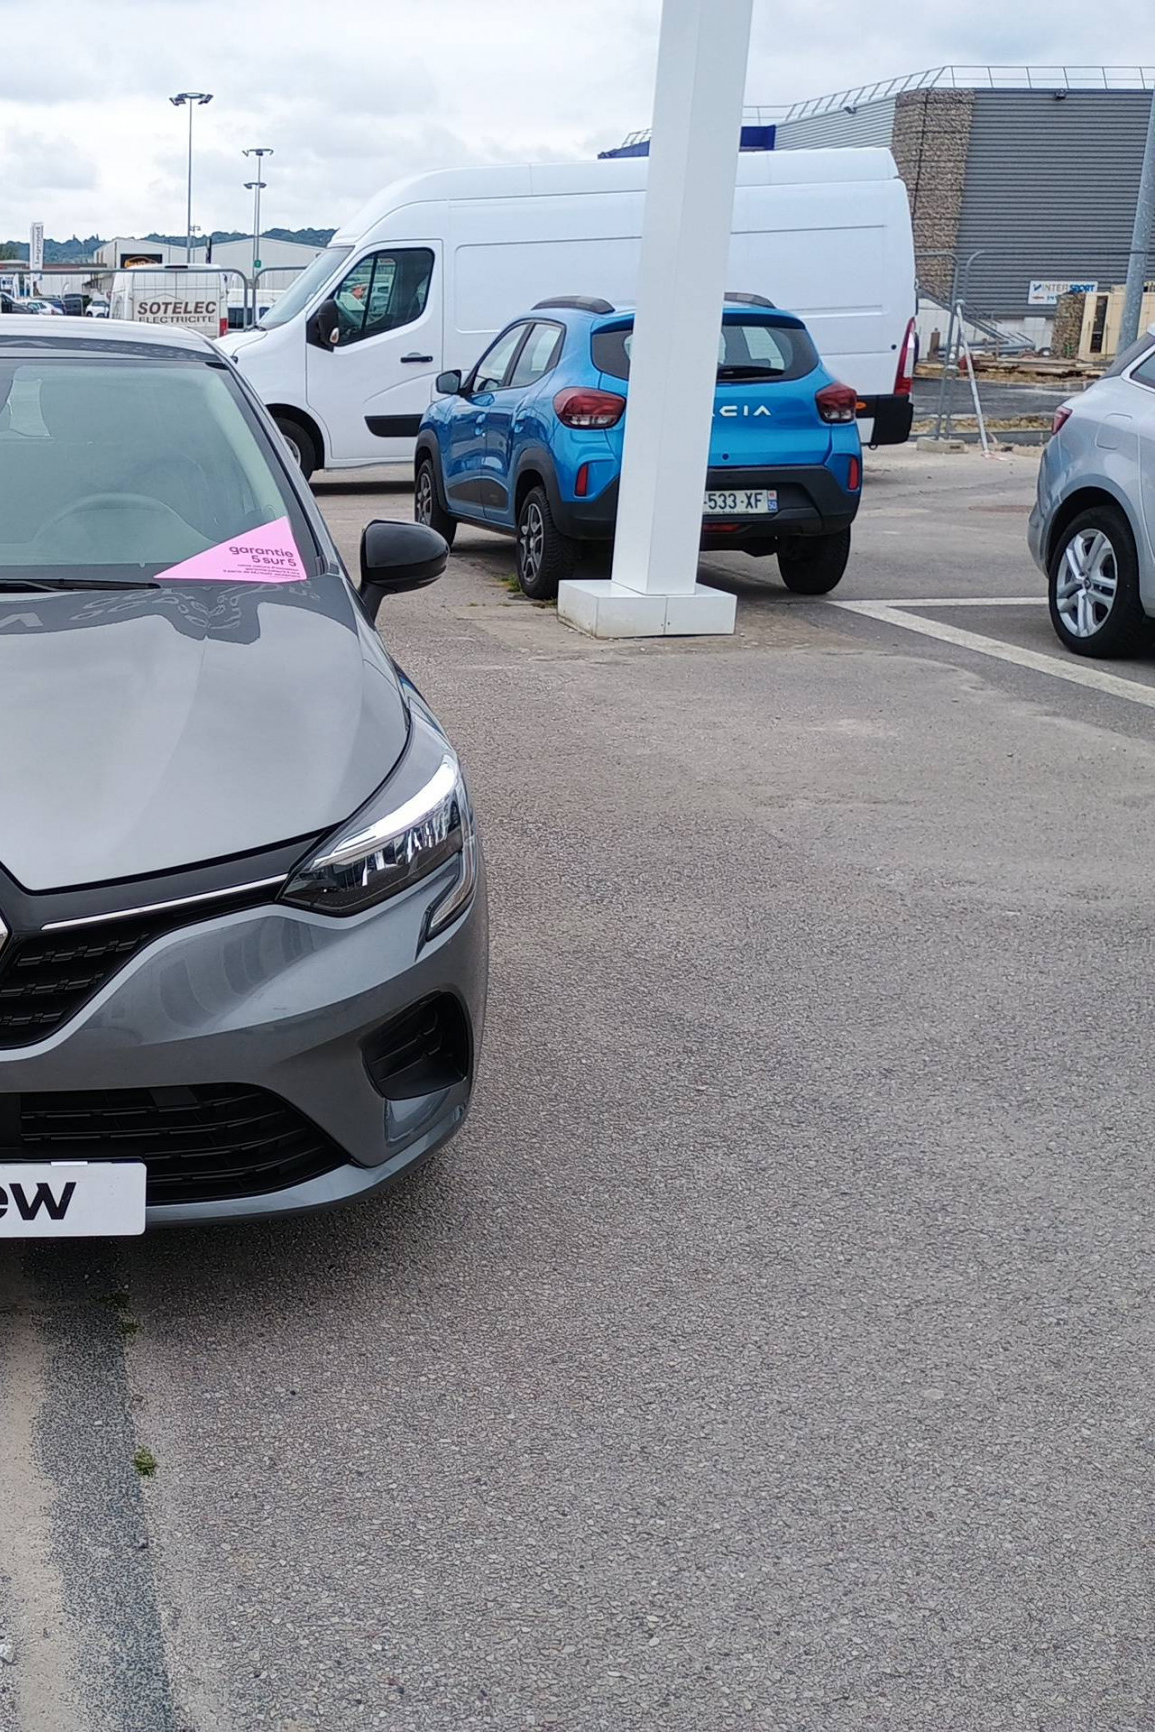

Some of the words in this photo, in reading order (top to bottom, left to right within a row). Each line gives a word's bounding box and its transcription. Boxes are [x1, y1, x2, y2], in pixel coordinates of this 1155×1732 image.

[137, 301, 217, 315] SOTELEC
[711, 405, 772, 416] CIA
[229, 546, 294, 558] garantie
[251, 555, 261, 563] 5
[262, 557, 285, 565] sur
[288, 559, 297, 567] 5
